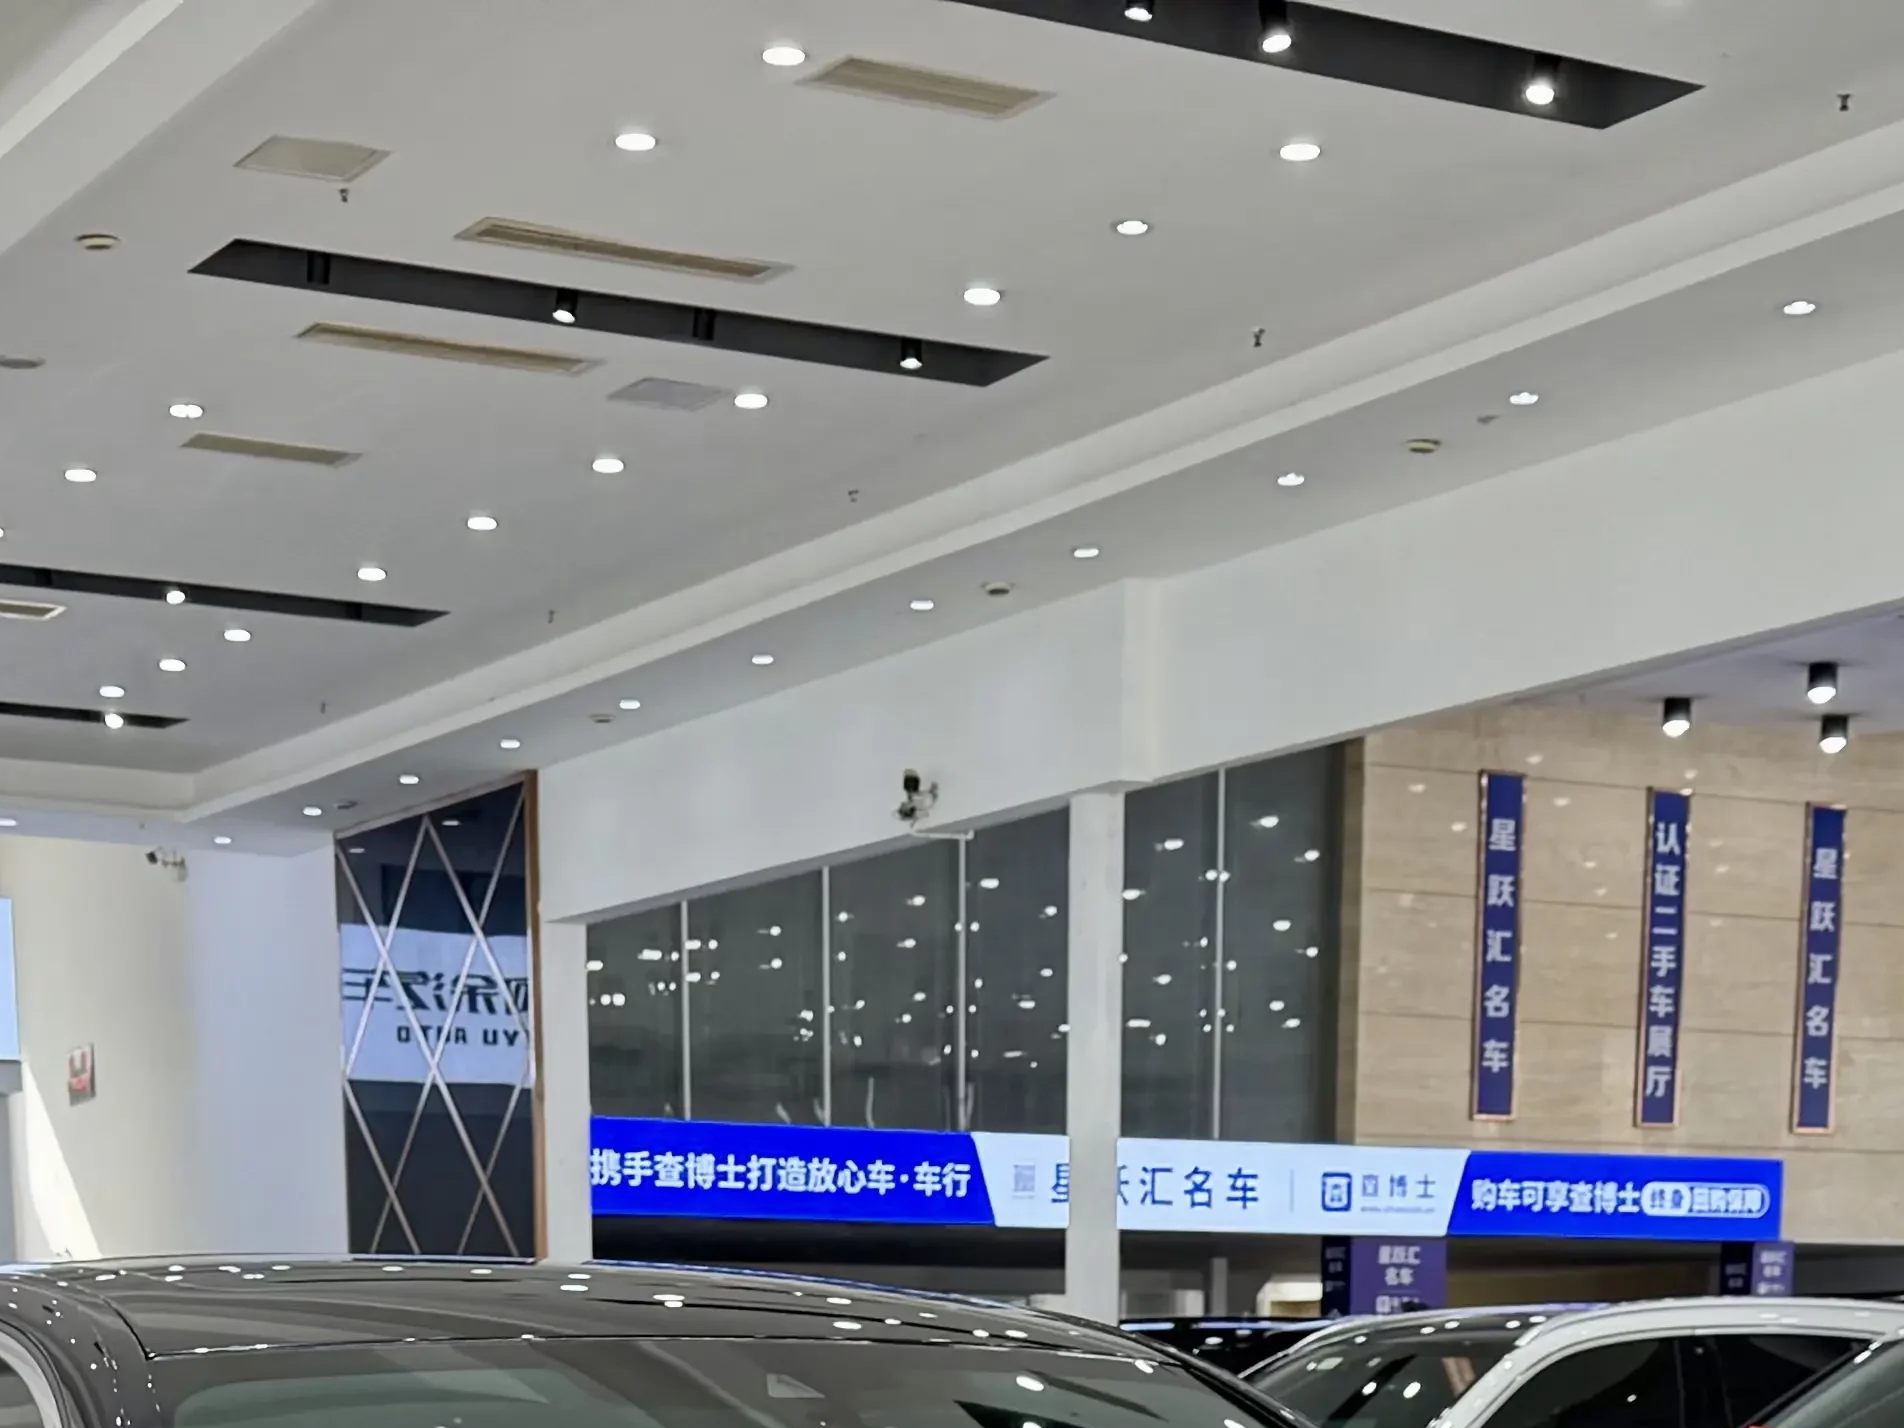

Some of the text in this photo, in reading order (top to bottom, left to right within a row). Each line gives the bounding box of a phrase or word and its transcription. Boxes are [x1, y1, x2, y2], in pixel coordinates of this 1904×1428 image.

[1481, 818, 1517, 1074] 星跃汇名车
[1645, 821, 1681, 1099] 认证二手车展厅
[1803, 847, 1838, 1090] 星跃汇名车
